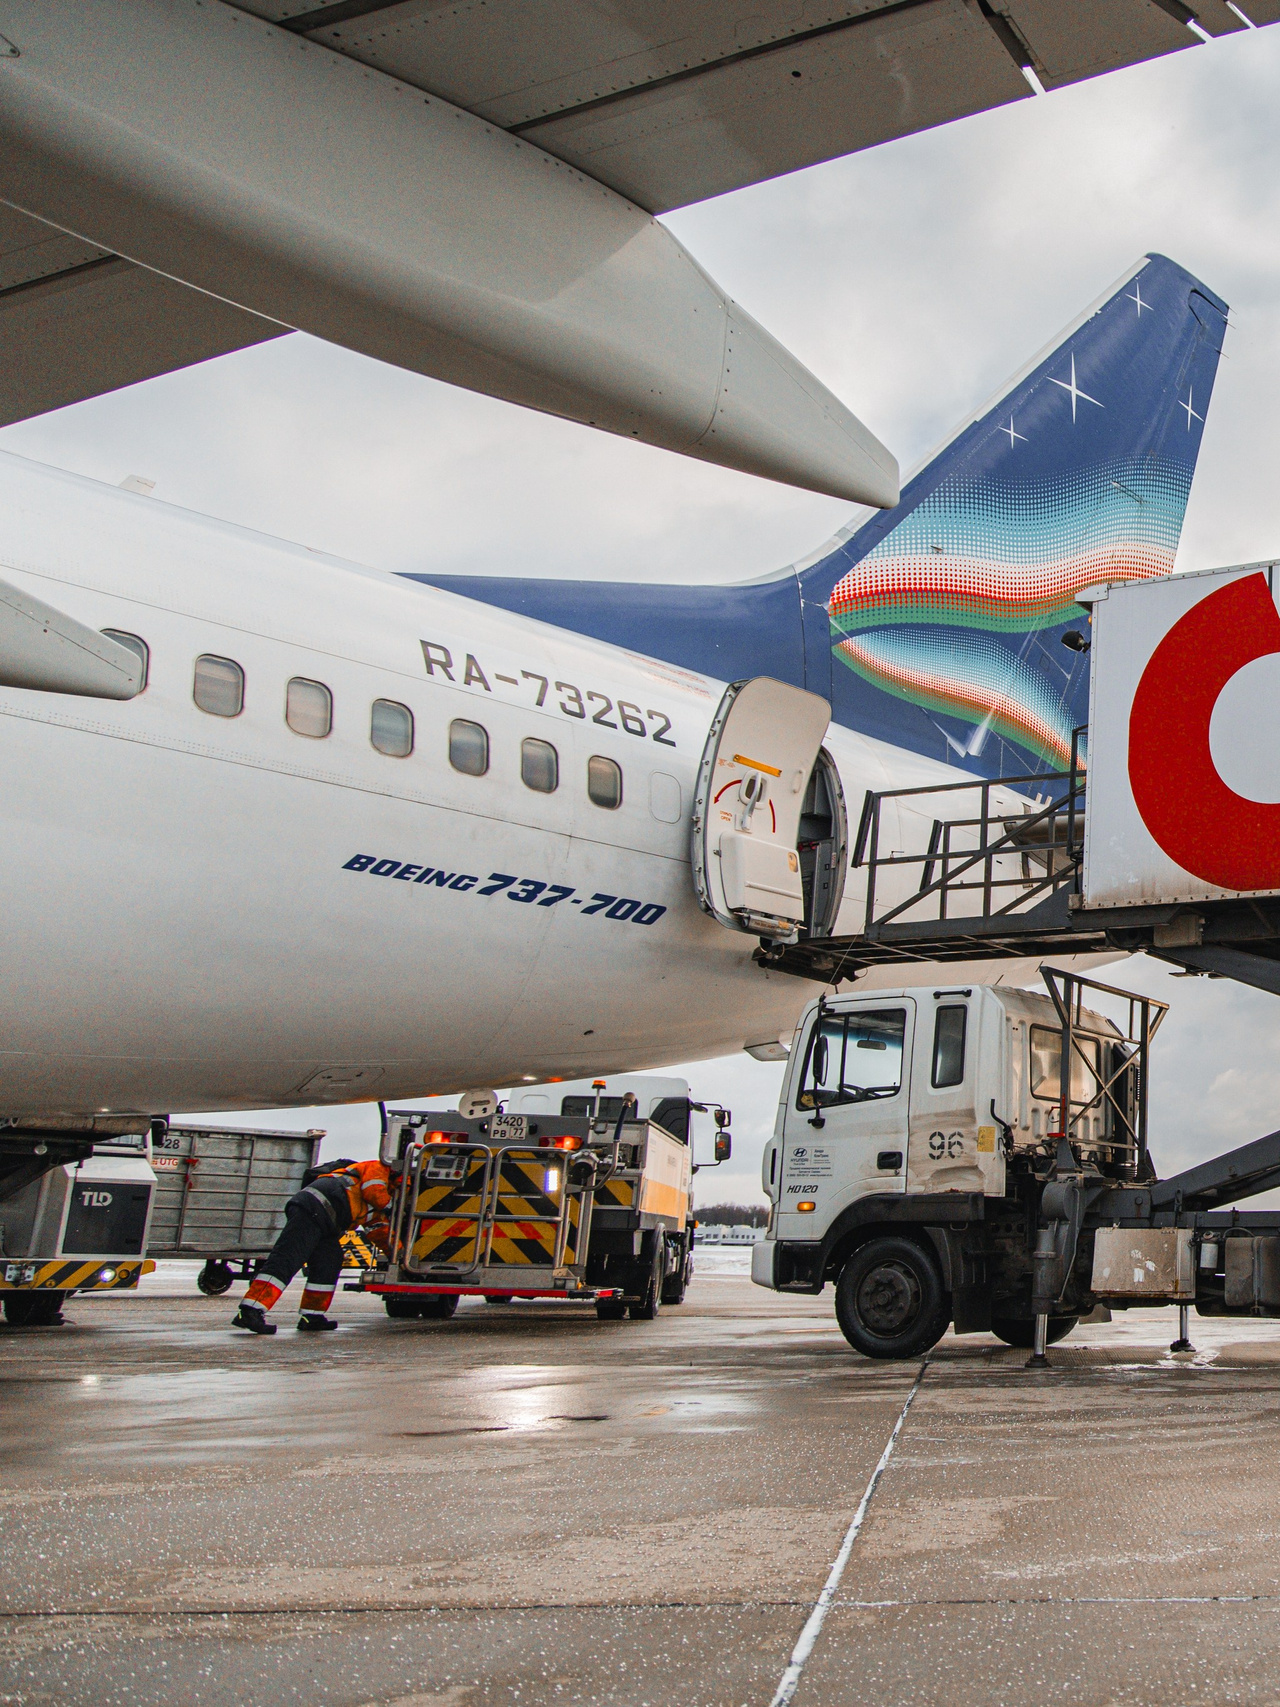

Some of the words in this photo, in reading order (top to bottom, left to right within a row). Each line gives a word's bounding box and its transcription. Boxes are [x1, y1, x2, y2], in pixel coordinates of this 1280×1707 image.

[420, 640, 677, 747] RA-73262
[341, 853, 479, 892] BOEING
[476, 872, 667, 925] 737-700
[496, 1116, 523, 1126] 3420
[513, 1128, 524, 1136] 77
[157, 1138, 180, 1149] 28
[929, 1131, 964, 1160] 96
[160, 1158, 179, 1167] UTG
[82, 1191, 113, 1206] TLD
